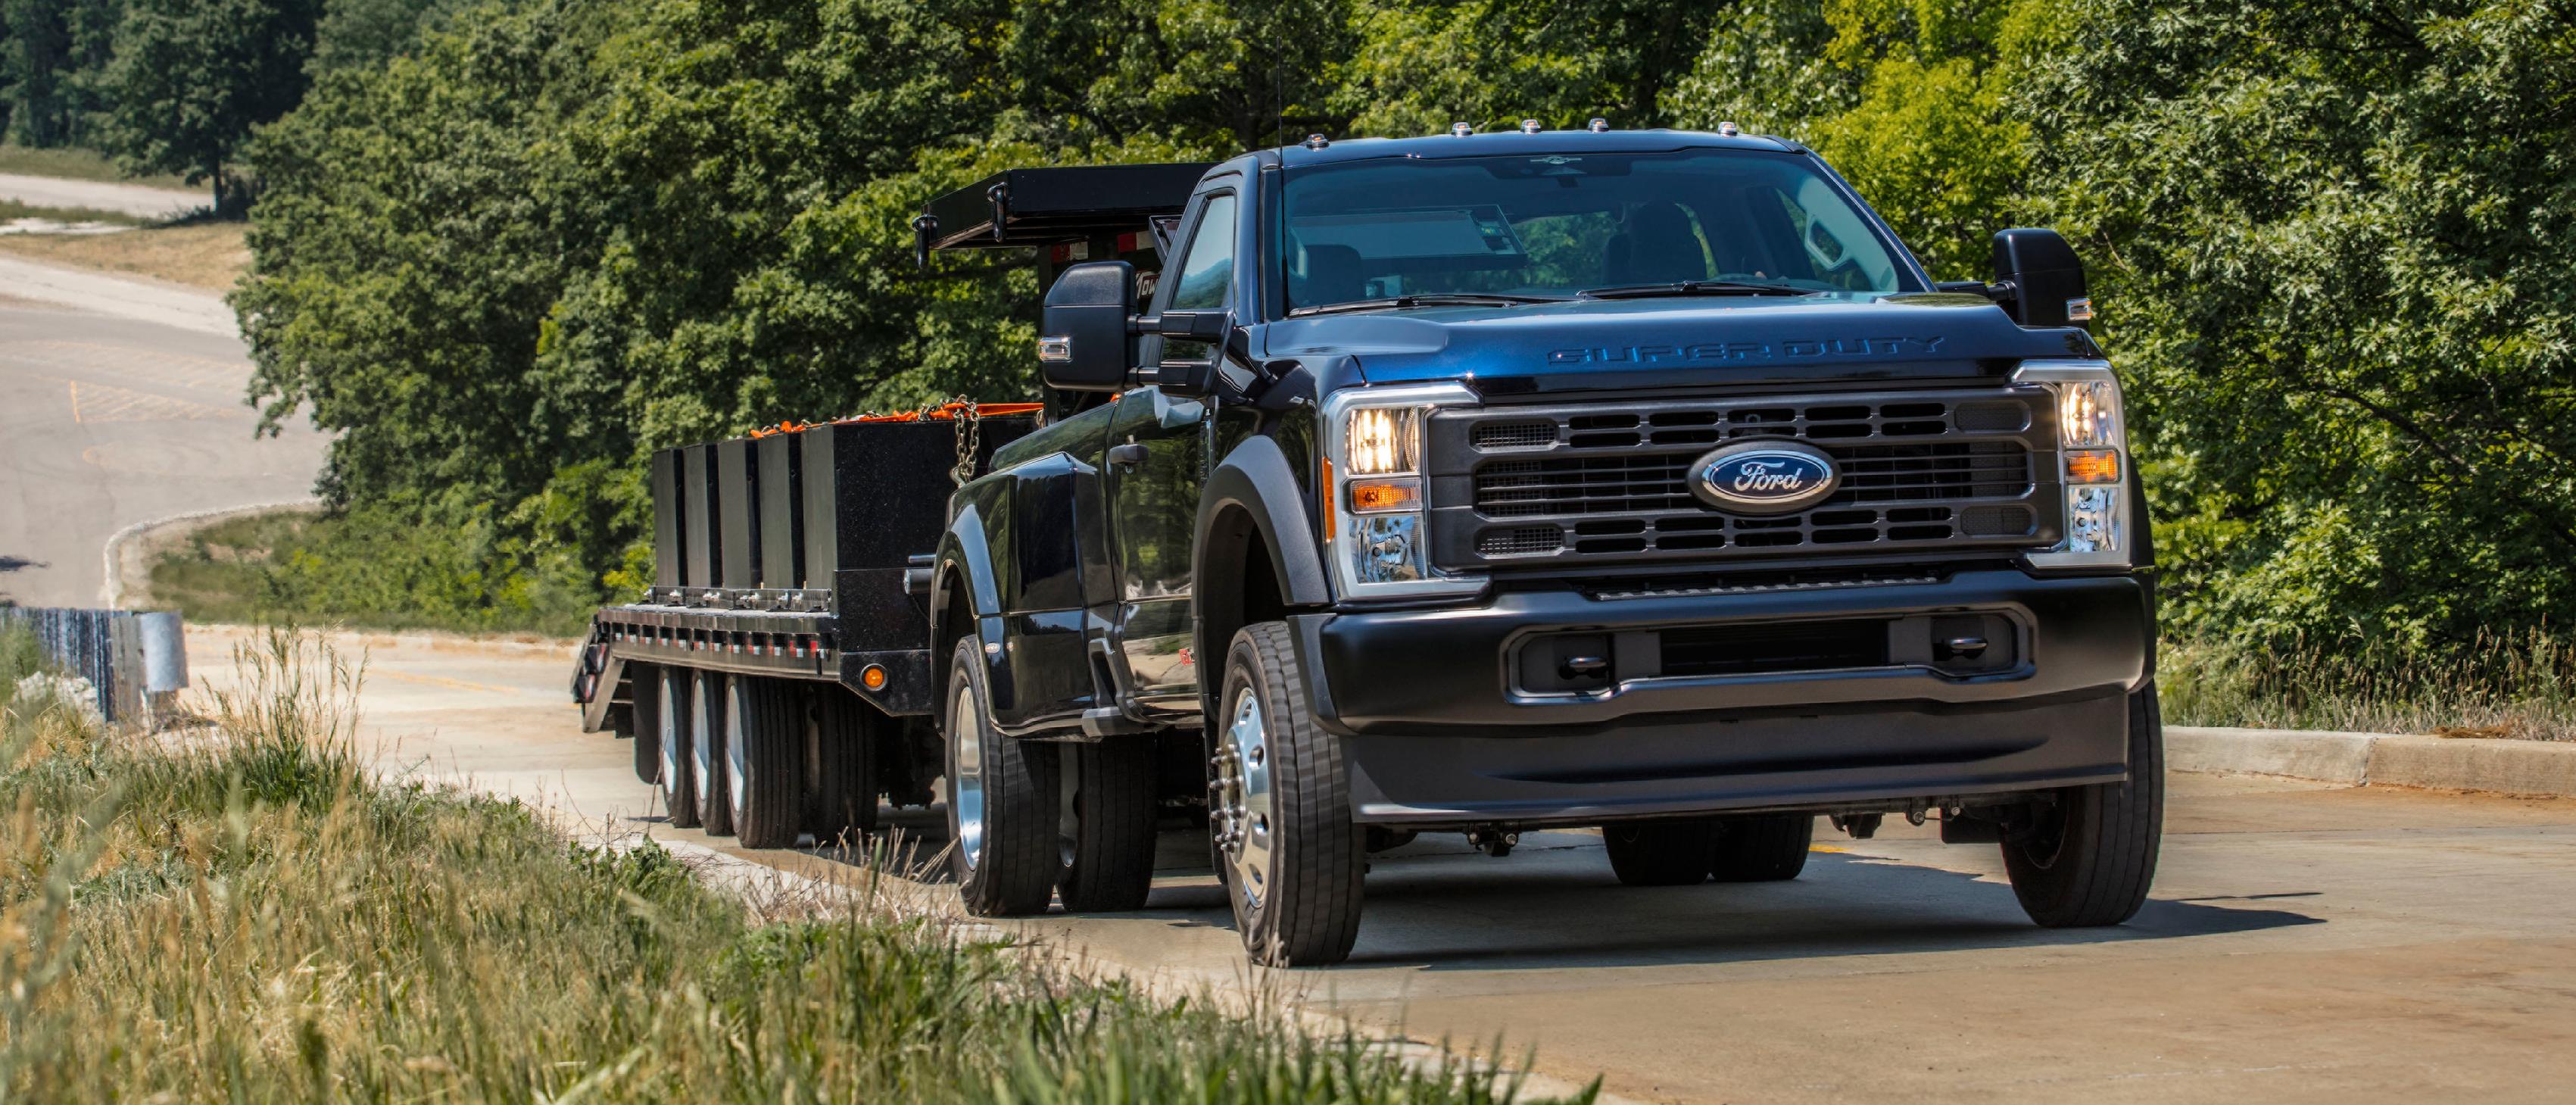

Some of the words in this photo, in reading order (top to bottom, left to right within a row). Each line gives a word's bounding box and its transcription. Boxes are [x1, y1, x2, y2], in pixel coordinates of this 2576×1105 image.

[1548, 342, 1773, 365] SUPER
[1782, 336, 1944, 357] DUTY
[1734, 462, 1803, 492] Ford
